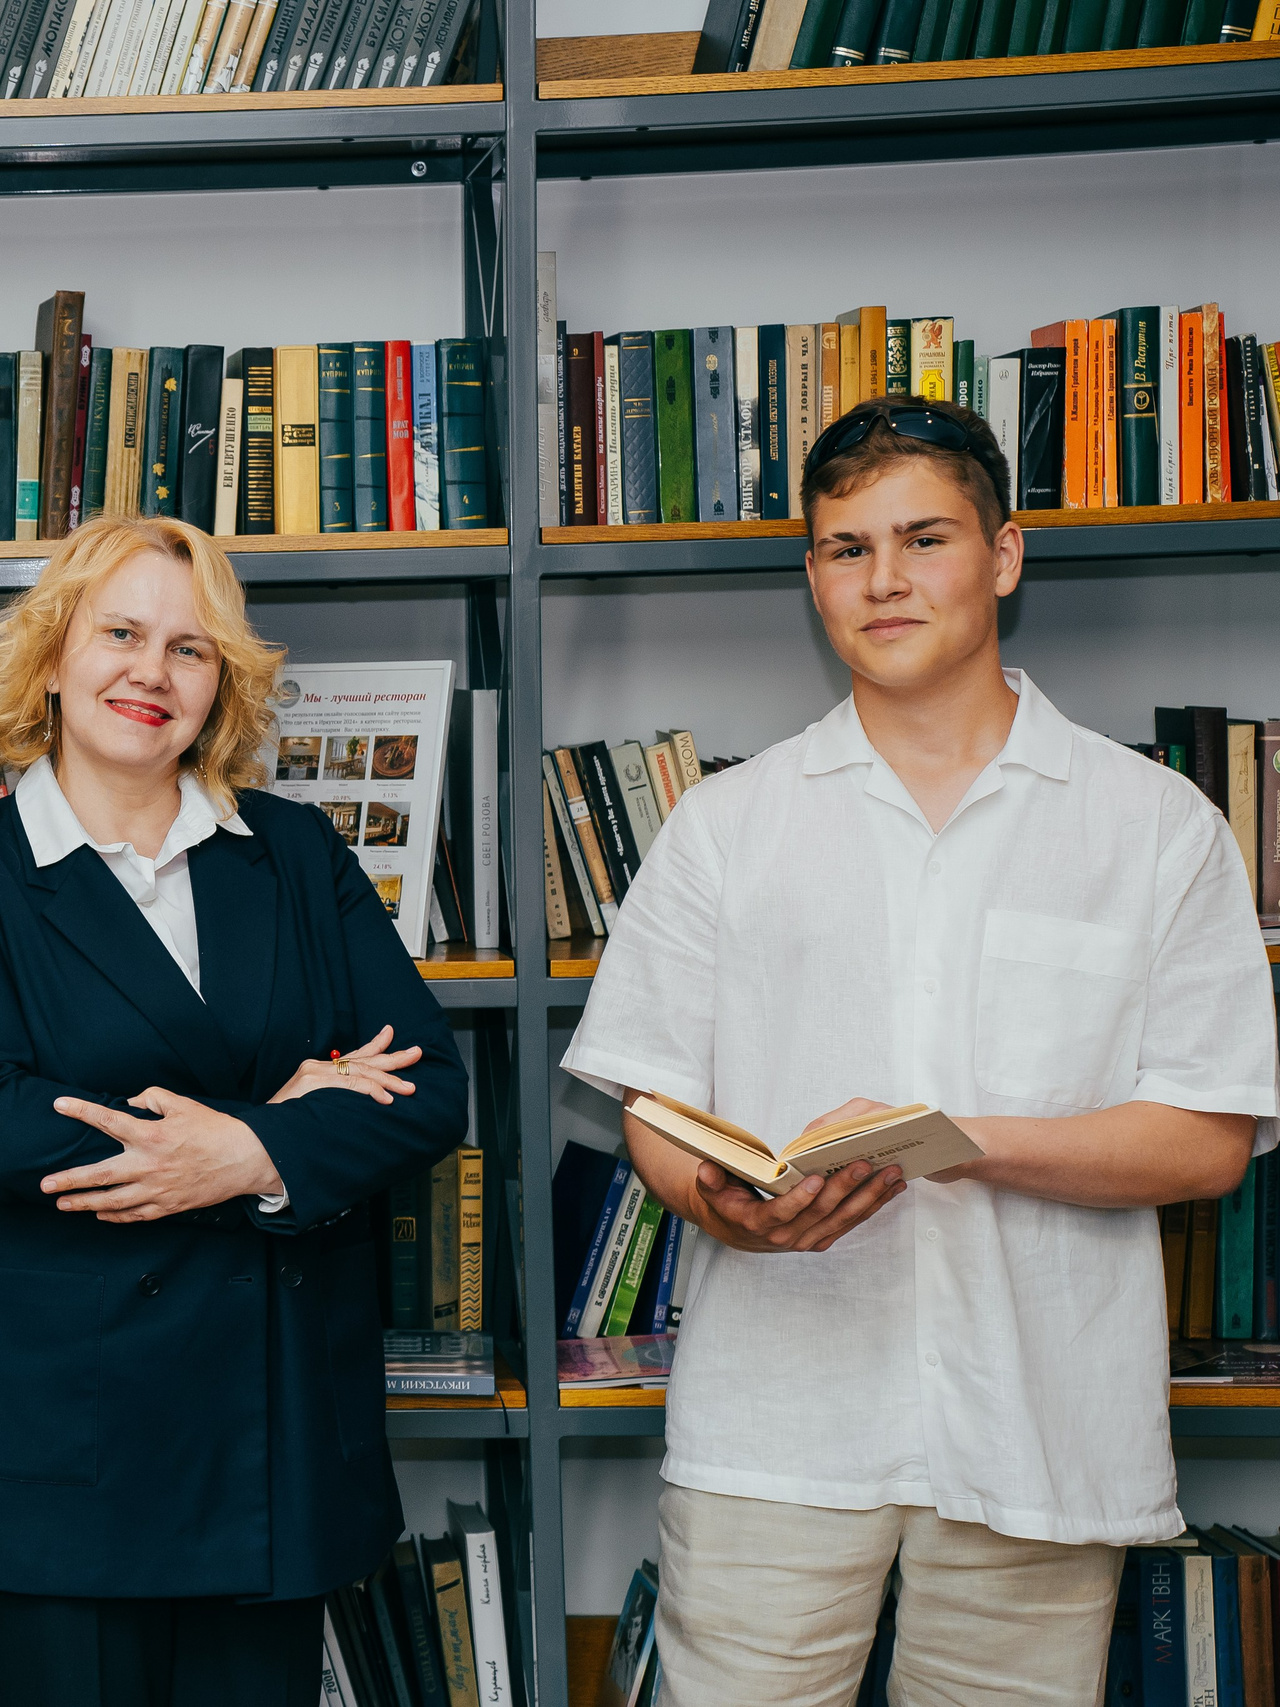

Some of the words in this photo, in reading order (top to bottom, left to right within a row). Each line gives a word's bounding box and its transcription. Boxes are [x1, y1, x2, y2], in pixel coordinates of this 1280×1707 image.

[318, 0, 343, 43] ПУАНК
[338, 4, 364, 54] АЛЕКСАНДР
[385, 3, 415, 54] ЖОРЖ
[410, 0, 436, 48] ДЖОН
[174, 34, 188, 66] РАССКАЗЫ
[1072, 338, 1080, 356] морей
[1134, 320, 1149, 368] Распутин
[1164, 346, 1175, 369] Перо
[1186, 326, 1194, 356] Паласио
[607, 364, 617, 402] сердца
[768, 359, 777, 384] ПОЭЗИИ
[799, 363, 808, 411] ДОБРЫЙ
[1134, 370, 1145, 380] В.
[1206, 367, 1217, 406] РОМАН
[75, 375, 88, 409] БУНИН
[125, 374, 139, 433] СТАНИСЛАВСКИЙ
[768, 386, 778, 422] ИРКУТСКОЙ
[159, 391, 170, 448] ПАУСТОВСКИЙ
[221, 406, 238, 466] ЕВТУШЕНКО
[392, 429, 409, 439] МОЙ
[419, 393, 432, 451] БАЙКАЛ
[558, 408, 566, 465] СОЗИДАТЕЛЬНЫХ
[608, 404, 617, 454] Память
[800, 415, 807, 423] В
[571, 425, 582, 460] КАТАЕВ
[769, 424, 778, 460] АНТОЛОГИЯ
[1207, 408, 1219, 485] АВАНТЮРНЫЙ
[222, 467, 234, 488] ЕВГ.
[572, 463, 584, 514] ВАЛЕНТИН
[741, 456, 753, 510] ВИКТОР
[1164, 476, 1175, 502] Марк
[334, 502, 340, 511] 3
[371, 501, 377, 510] 2
[303, 693, 322, 703] Мы
[330, 692, 372, 704] лучший
[373, 692, 427, 704] ресторан
[480, 795, 491, 836] РОЗОВА
[481, 840, 491, 866] СВЕТ
[877, 1140, 925, 1158] ЛЮБОВЬ
[397, 1222, 412, 1239] 20
[576, 1245, 600, 1287] МОЛОДОСТЬ
[591, 1213, 610, 1247] ГЕНРИХА
[661, 1241, 674, 1282] МОЛОДОСТЬ
[400, 1380, 470, 1390] ИРКУТСКИЙ
[475, 1542, 490, 1574] первая
[479, 1577, 492, 1605] Книга
[1152, 1562, 1171, 1607] ТВЕН
[1152, 1610, 1173, 1664] МАРК
[320, 1667, 337, 1695] 2008
[483, 1658, 503, 1702] Казанцев
